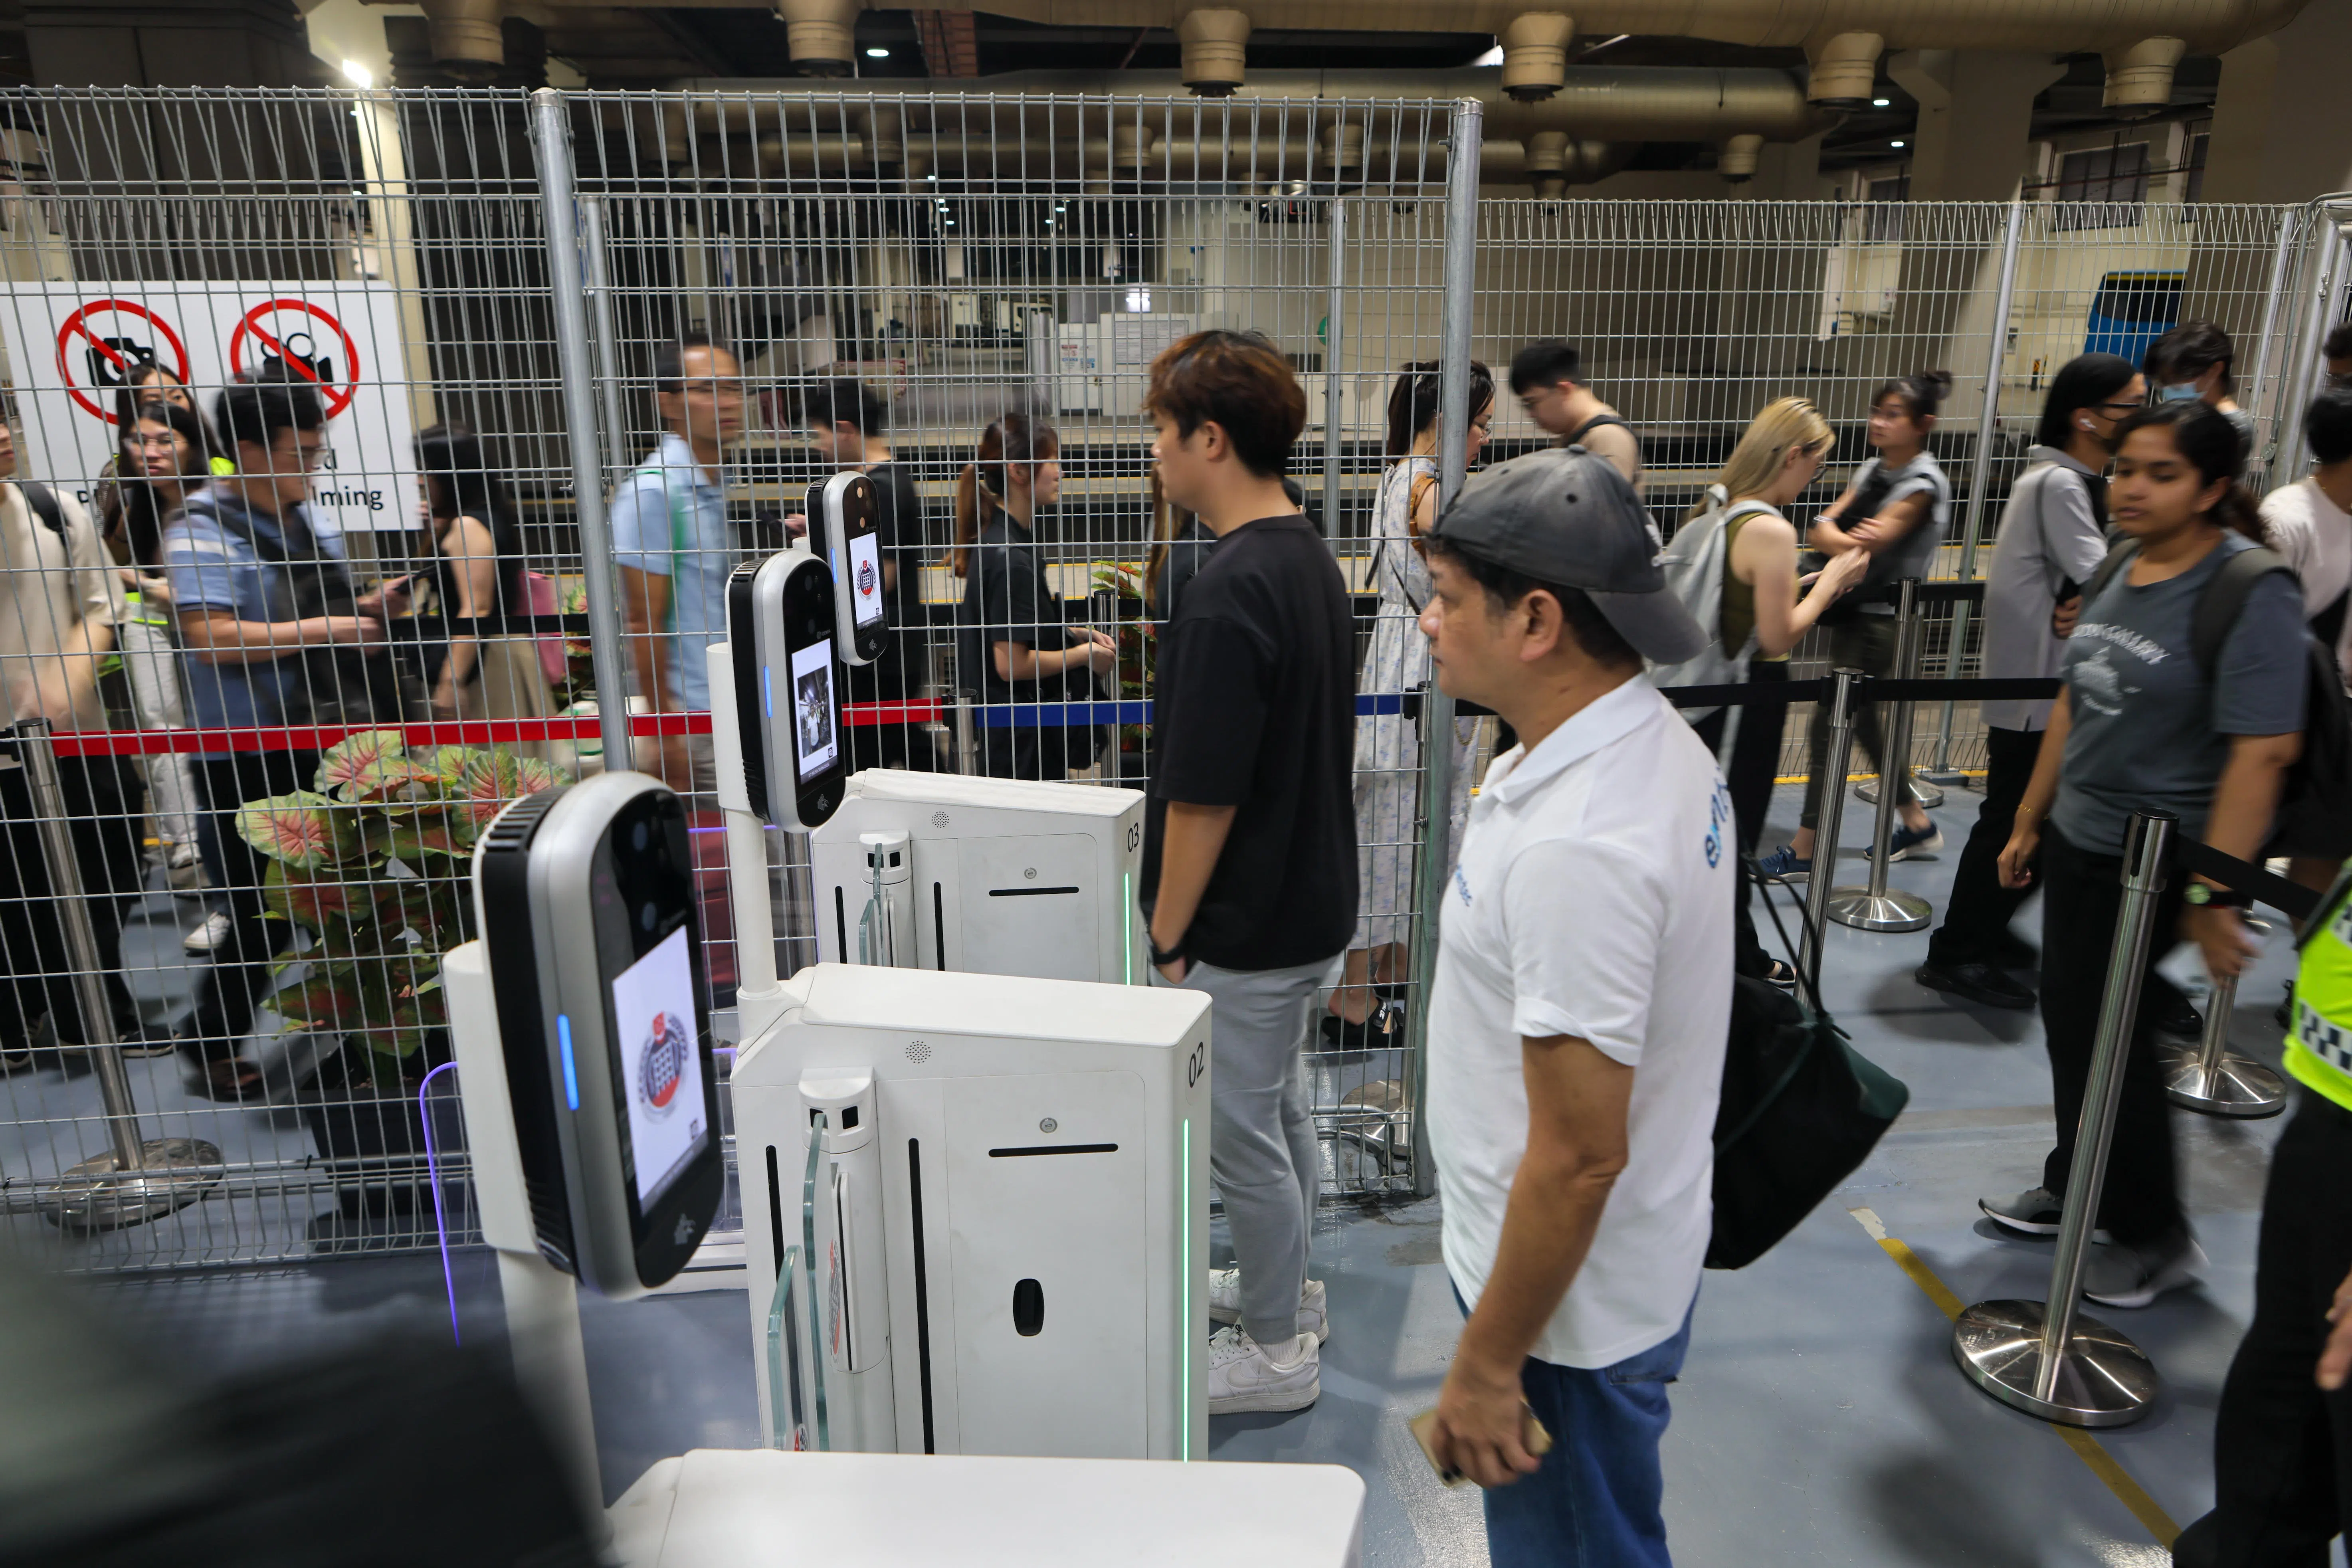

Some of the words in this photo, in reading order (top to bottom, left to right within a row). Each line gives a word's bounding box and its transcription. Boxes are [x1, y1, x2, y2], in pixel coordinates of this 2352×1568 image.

[313, 485, 384, 511] lming
[1128, 822, 1139, 853] 03
[1189, 1041, 1204, 1088] 02
